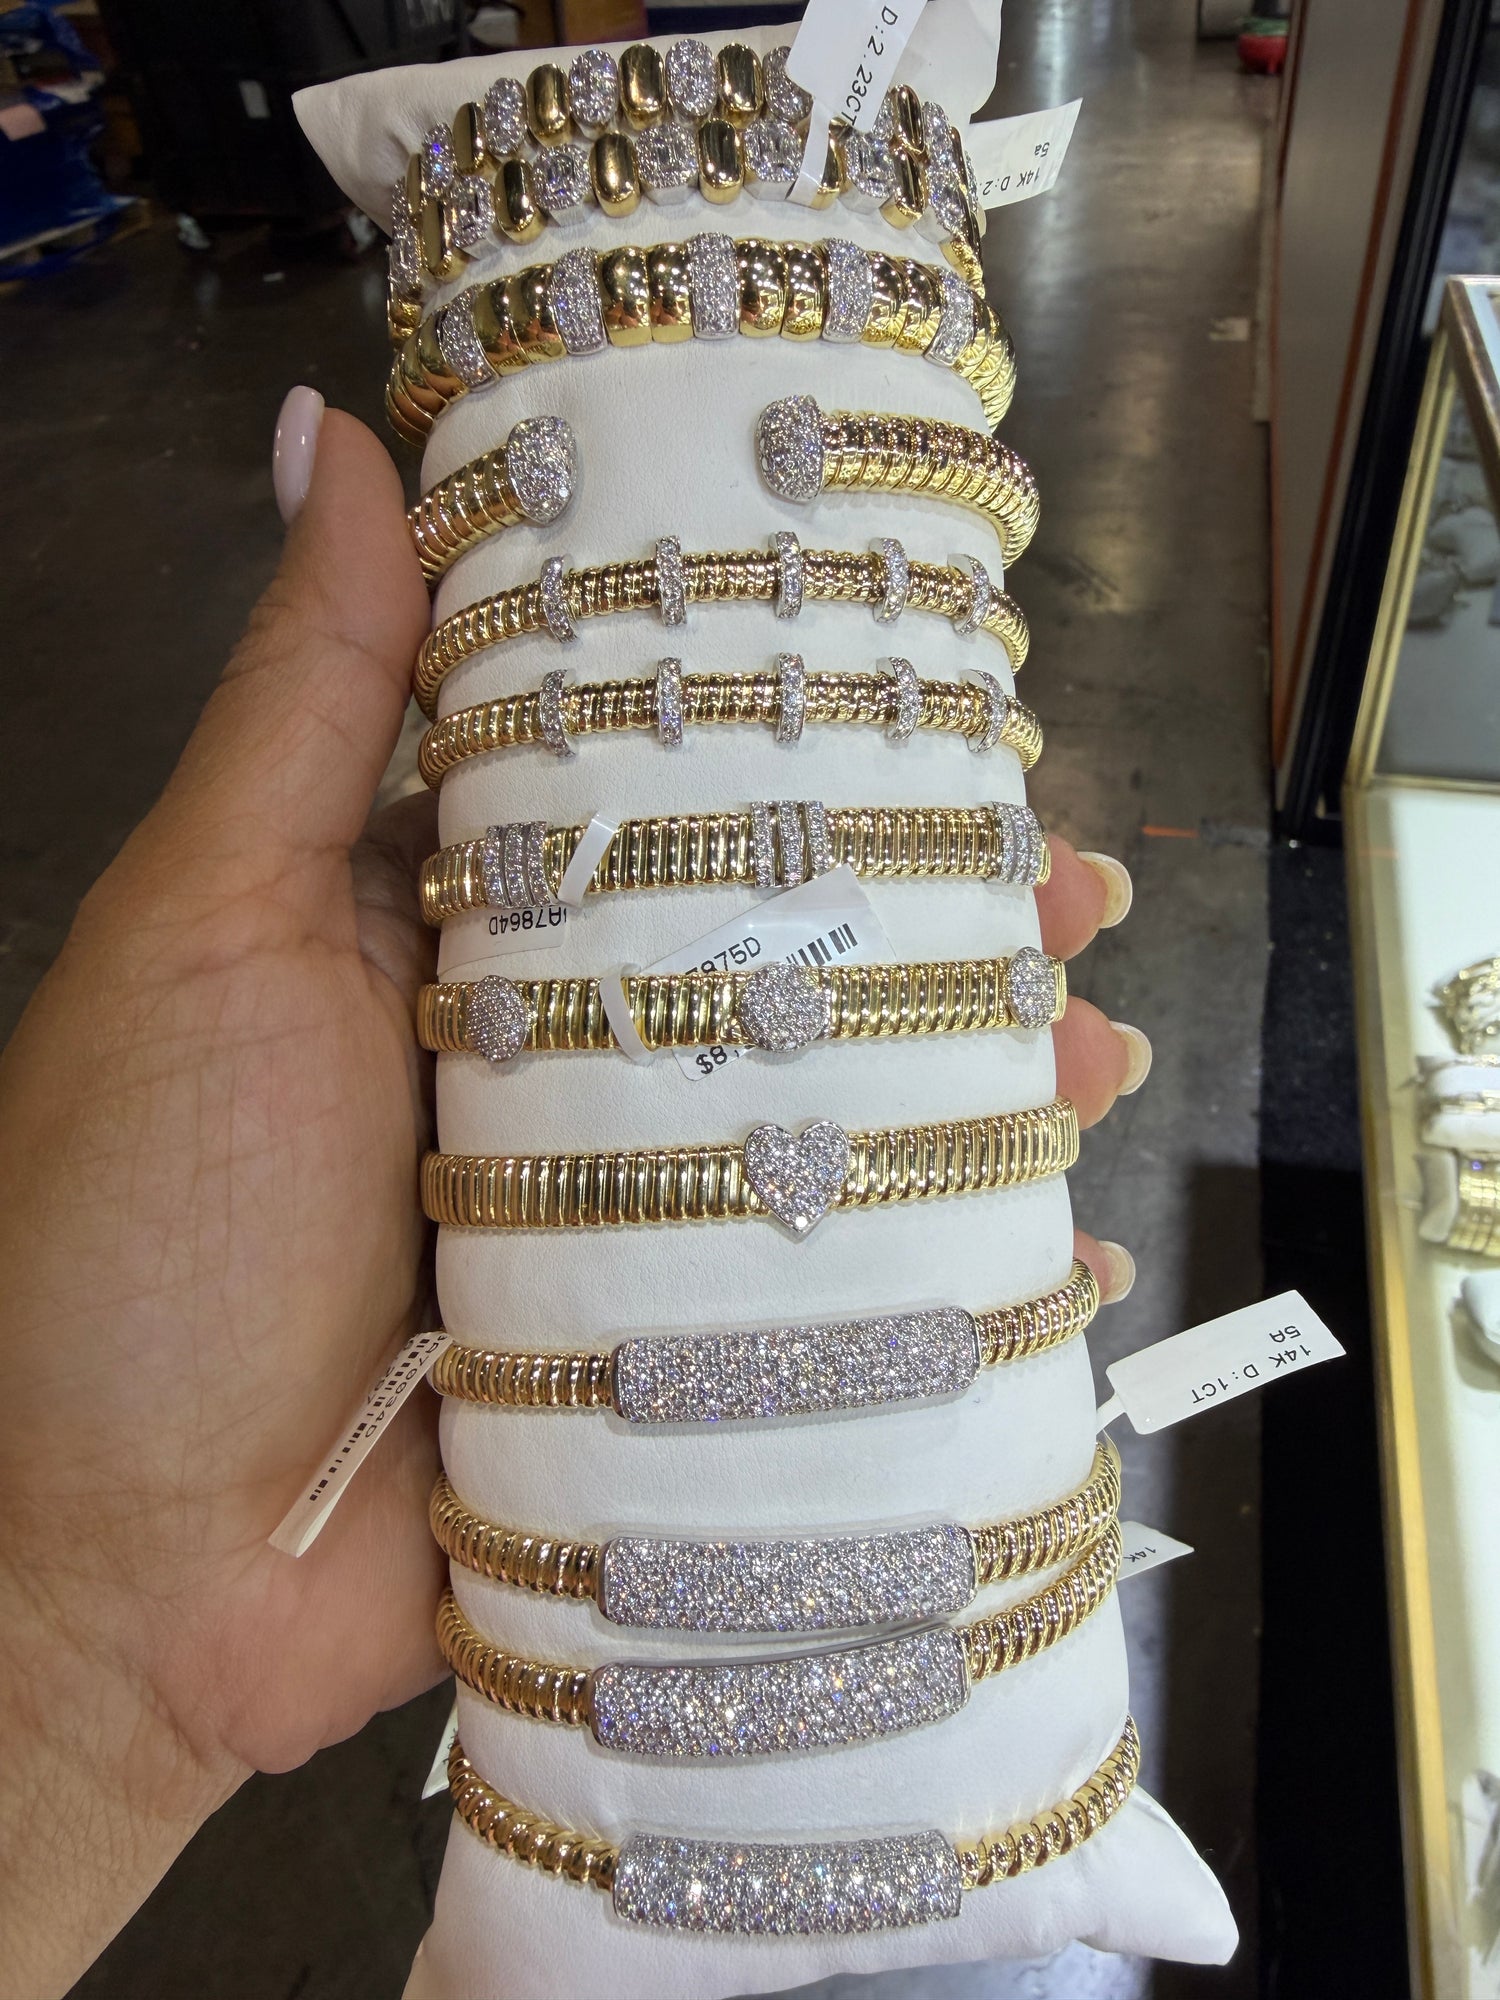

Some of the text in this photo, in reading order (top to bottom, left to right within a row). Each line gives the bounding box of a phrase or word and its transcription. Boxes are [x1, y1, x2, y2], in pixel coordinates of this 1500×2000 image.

[841, 6, 898, 126] D:2.23CT
[1016, 168, 1040, 188] 14K
[1269, 1325, 1302, 1343] 5A
[1191, 1344, 1311, 1404] 14K D:1CT
[1123, 1547, 1156, 1563] 14K
